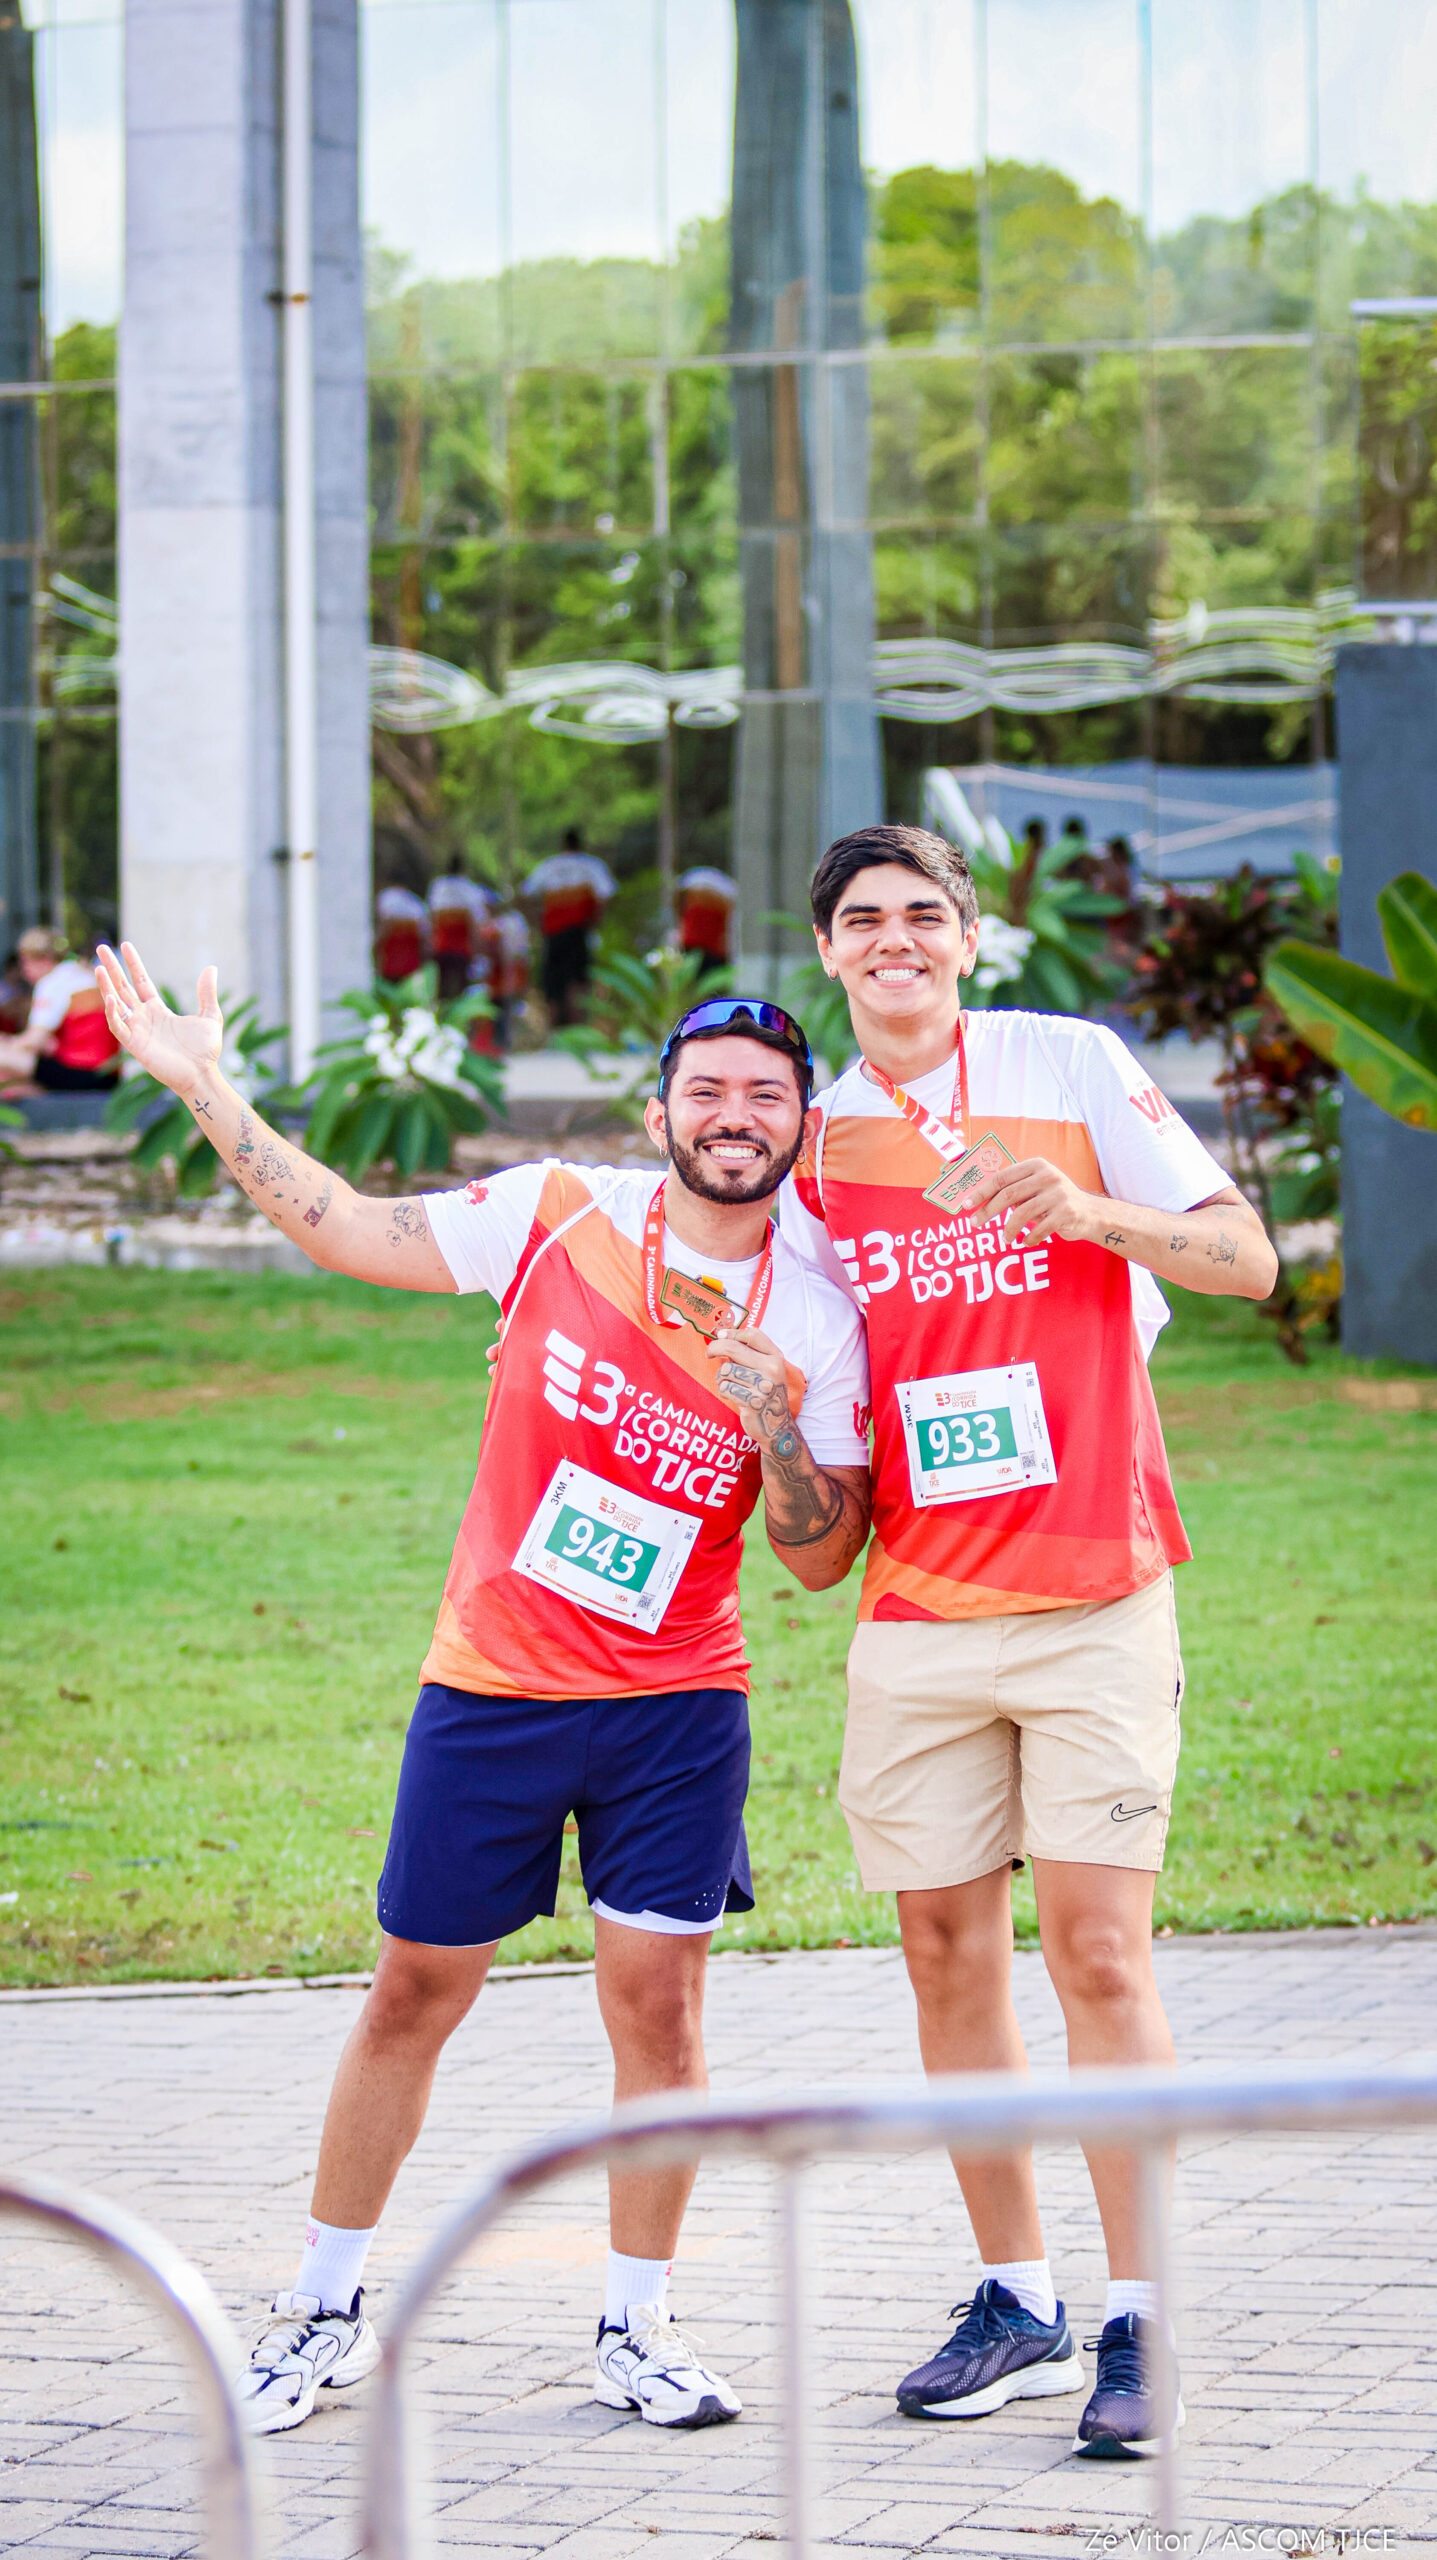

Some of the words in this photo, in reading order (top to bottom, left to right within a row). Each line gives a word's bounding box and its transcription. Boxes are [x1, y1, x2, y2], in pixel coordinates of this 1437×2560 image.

[910, 1270, 953, 1303] DO
[955, 1249, 1050, 1304] TJCE
[579, 1360, 637, 1426] 3ª
[638, 1391, 760, 1454] CAMINHADA
[904, 1404, 913, 1428] 3KM
[928, 1413, 1001, 1466] 933
[550, 1481, 568, 1506] 3KM
[613, 1428, 652, 1465] DO
[651, 1448, 739, 1508] TJCE
[561, 1517, 644, 1582] 943
